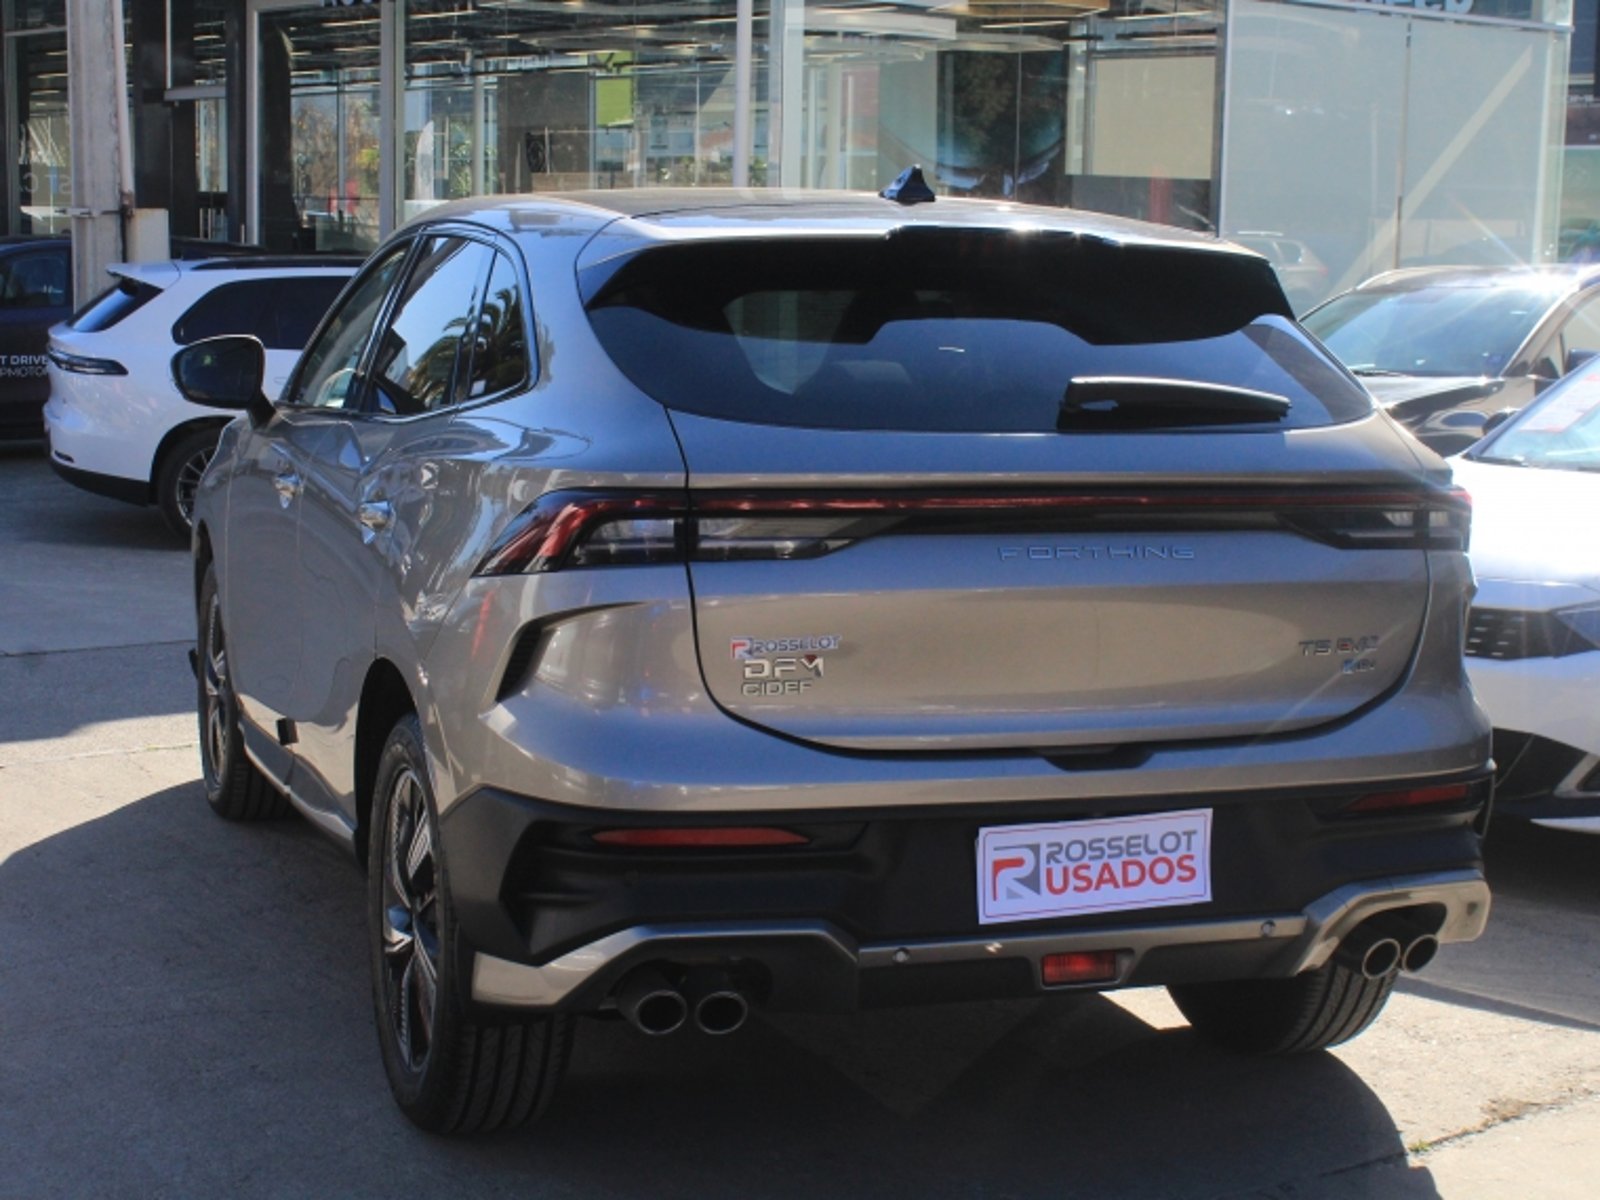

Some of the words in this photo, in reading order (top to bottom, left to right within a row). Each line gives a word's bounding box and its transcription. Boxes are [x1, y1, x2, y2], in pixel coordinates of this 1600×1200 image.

[10, 355, 48, 365] DRIVE
[998, 546, 1195, 560] FORTHING
[754, 636, 841, 653] ROSSELOT
[741, 680, 812, 696] CIDEF
[1046, 830, 1198, 864] ROSSELOT
[1045, 854, 1197, 895] USADOS
